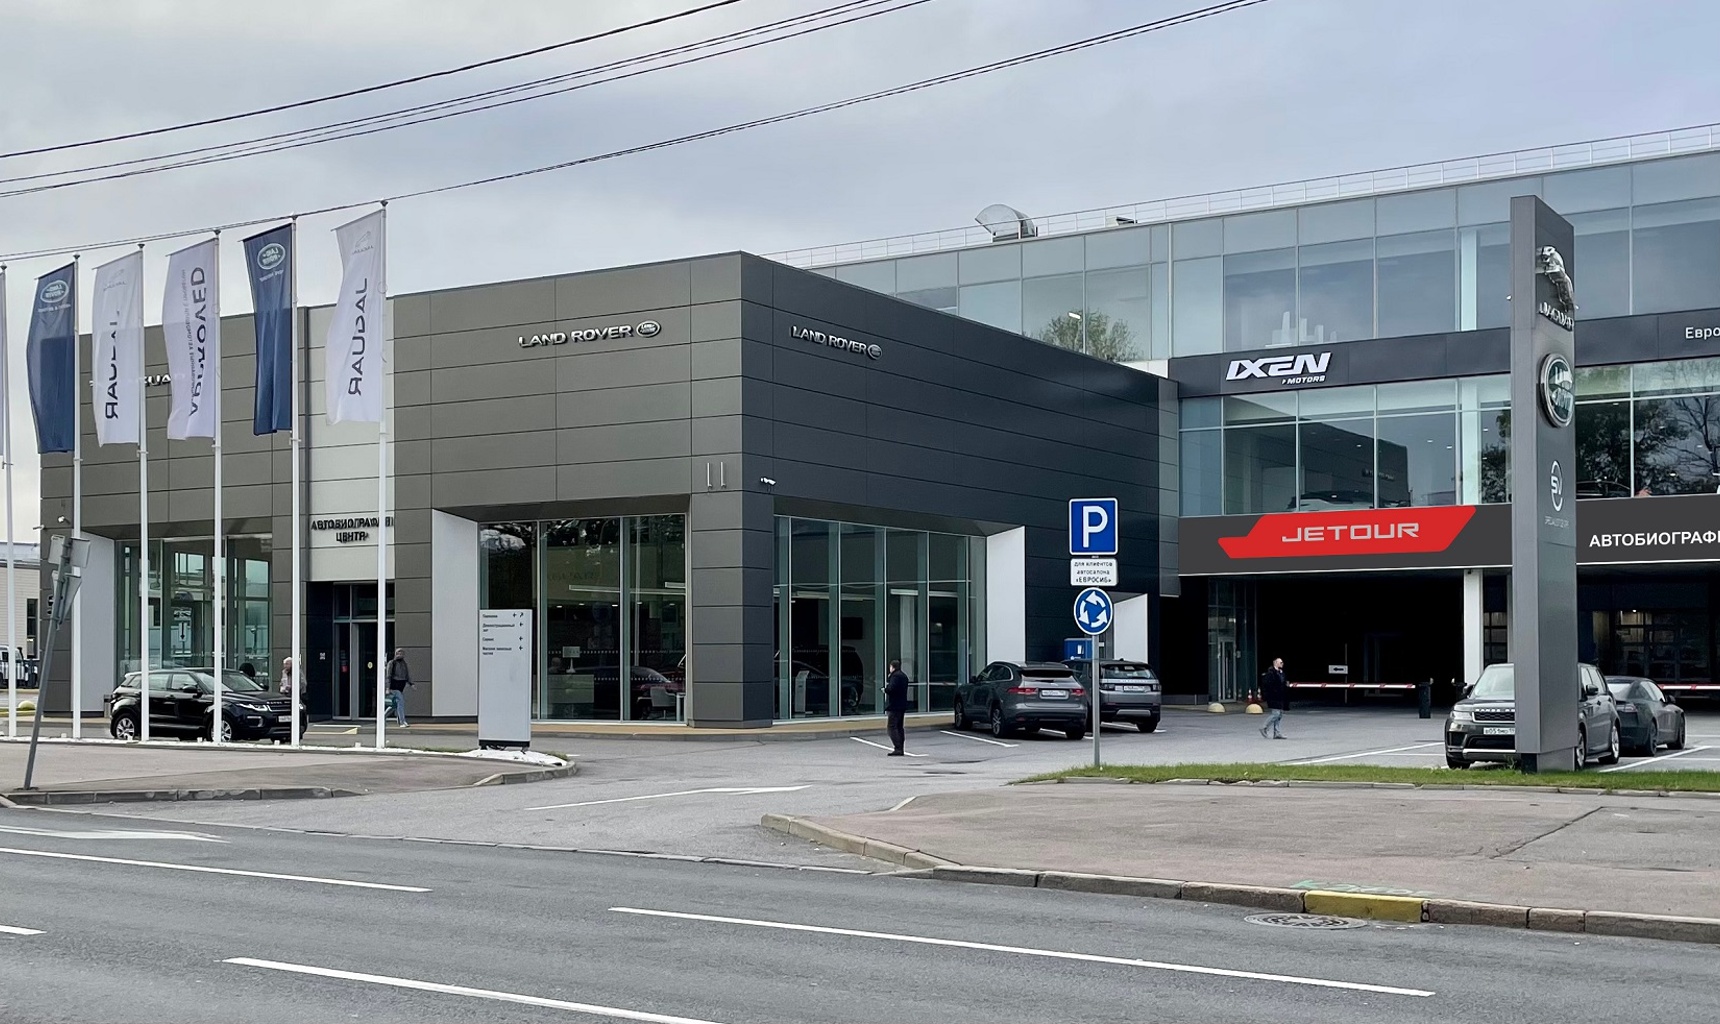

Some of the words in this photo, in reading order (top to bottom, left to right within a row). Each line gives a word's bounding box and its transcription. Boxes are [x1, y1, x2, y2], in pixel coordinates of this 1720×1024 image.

[518, 332, 566, 347] LAND
[571, 325, 633, 342] ROVER
[791, 326, 826, 344] LAND
[828, 335, 867, 354] ROVER
[1685, 326, 1720, 340] Евро
[1286, 375, 1326, 385] MOTORS
[336, 531, 367, 543] ЦЕНТР
[1281, 522, 1420, 543] JETOUR
